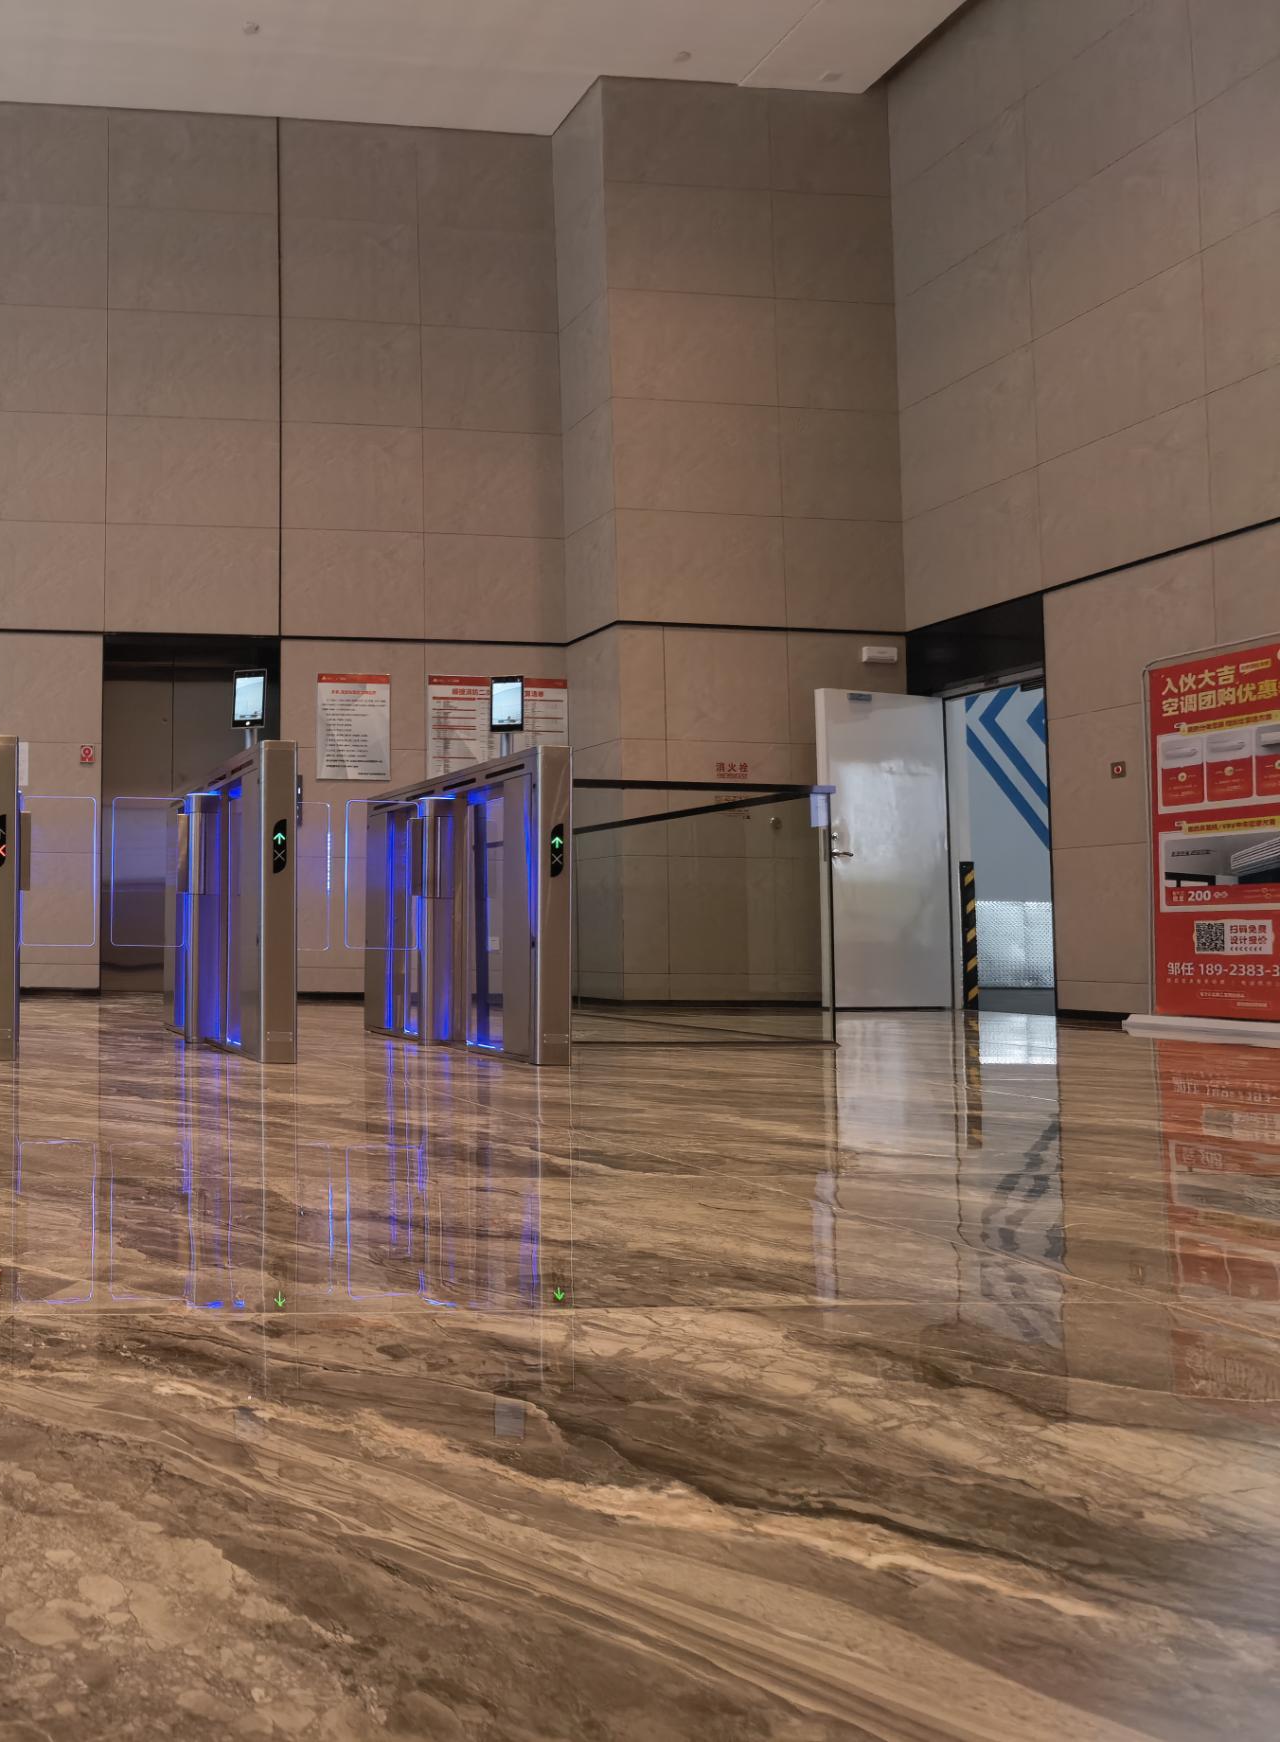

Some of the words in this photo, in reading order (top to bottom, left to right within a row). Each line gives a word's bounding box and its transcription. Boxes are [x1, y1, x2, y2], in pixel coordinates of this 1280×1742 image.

[1161, 665, 1236, 696] 入伙大吉
[1162, 679, 1280, 717] 空调团购优惠
[715, 762, 749, 773] 消火栓
[1187, 890, 1212, 902] 200
[1230, 924, 1267, 934] 扫码免费
[1230, 935, 1268, 945] 设计报价
[1167, 962, 1194, 976] 邹任
